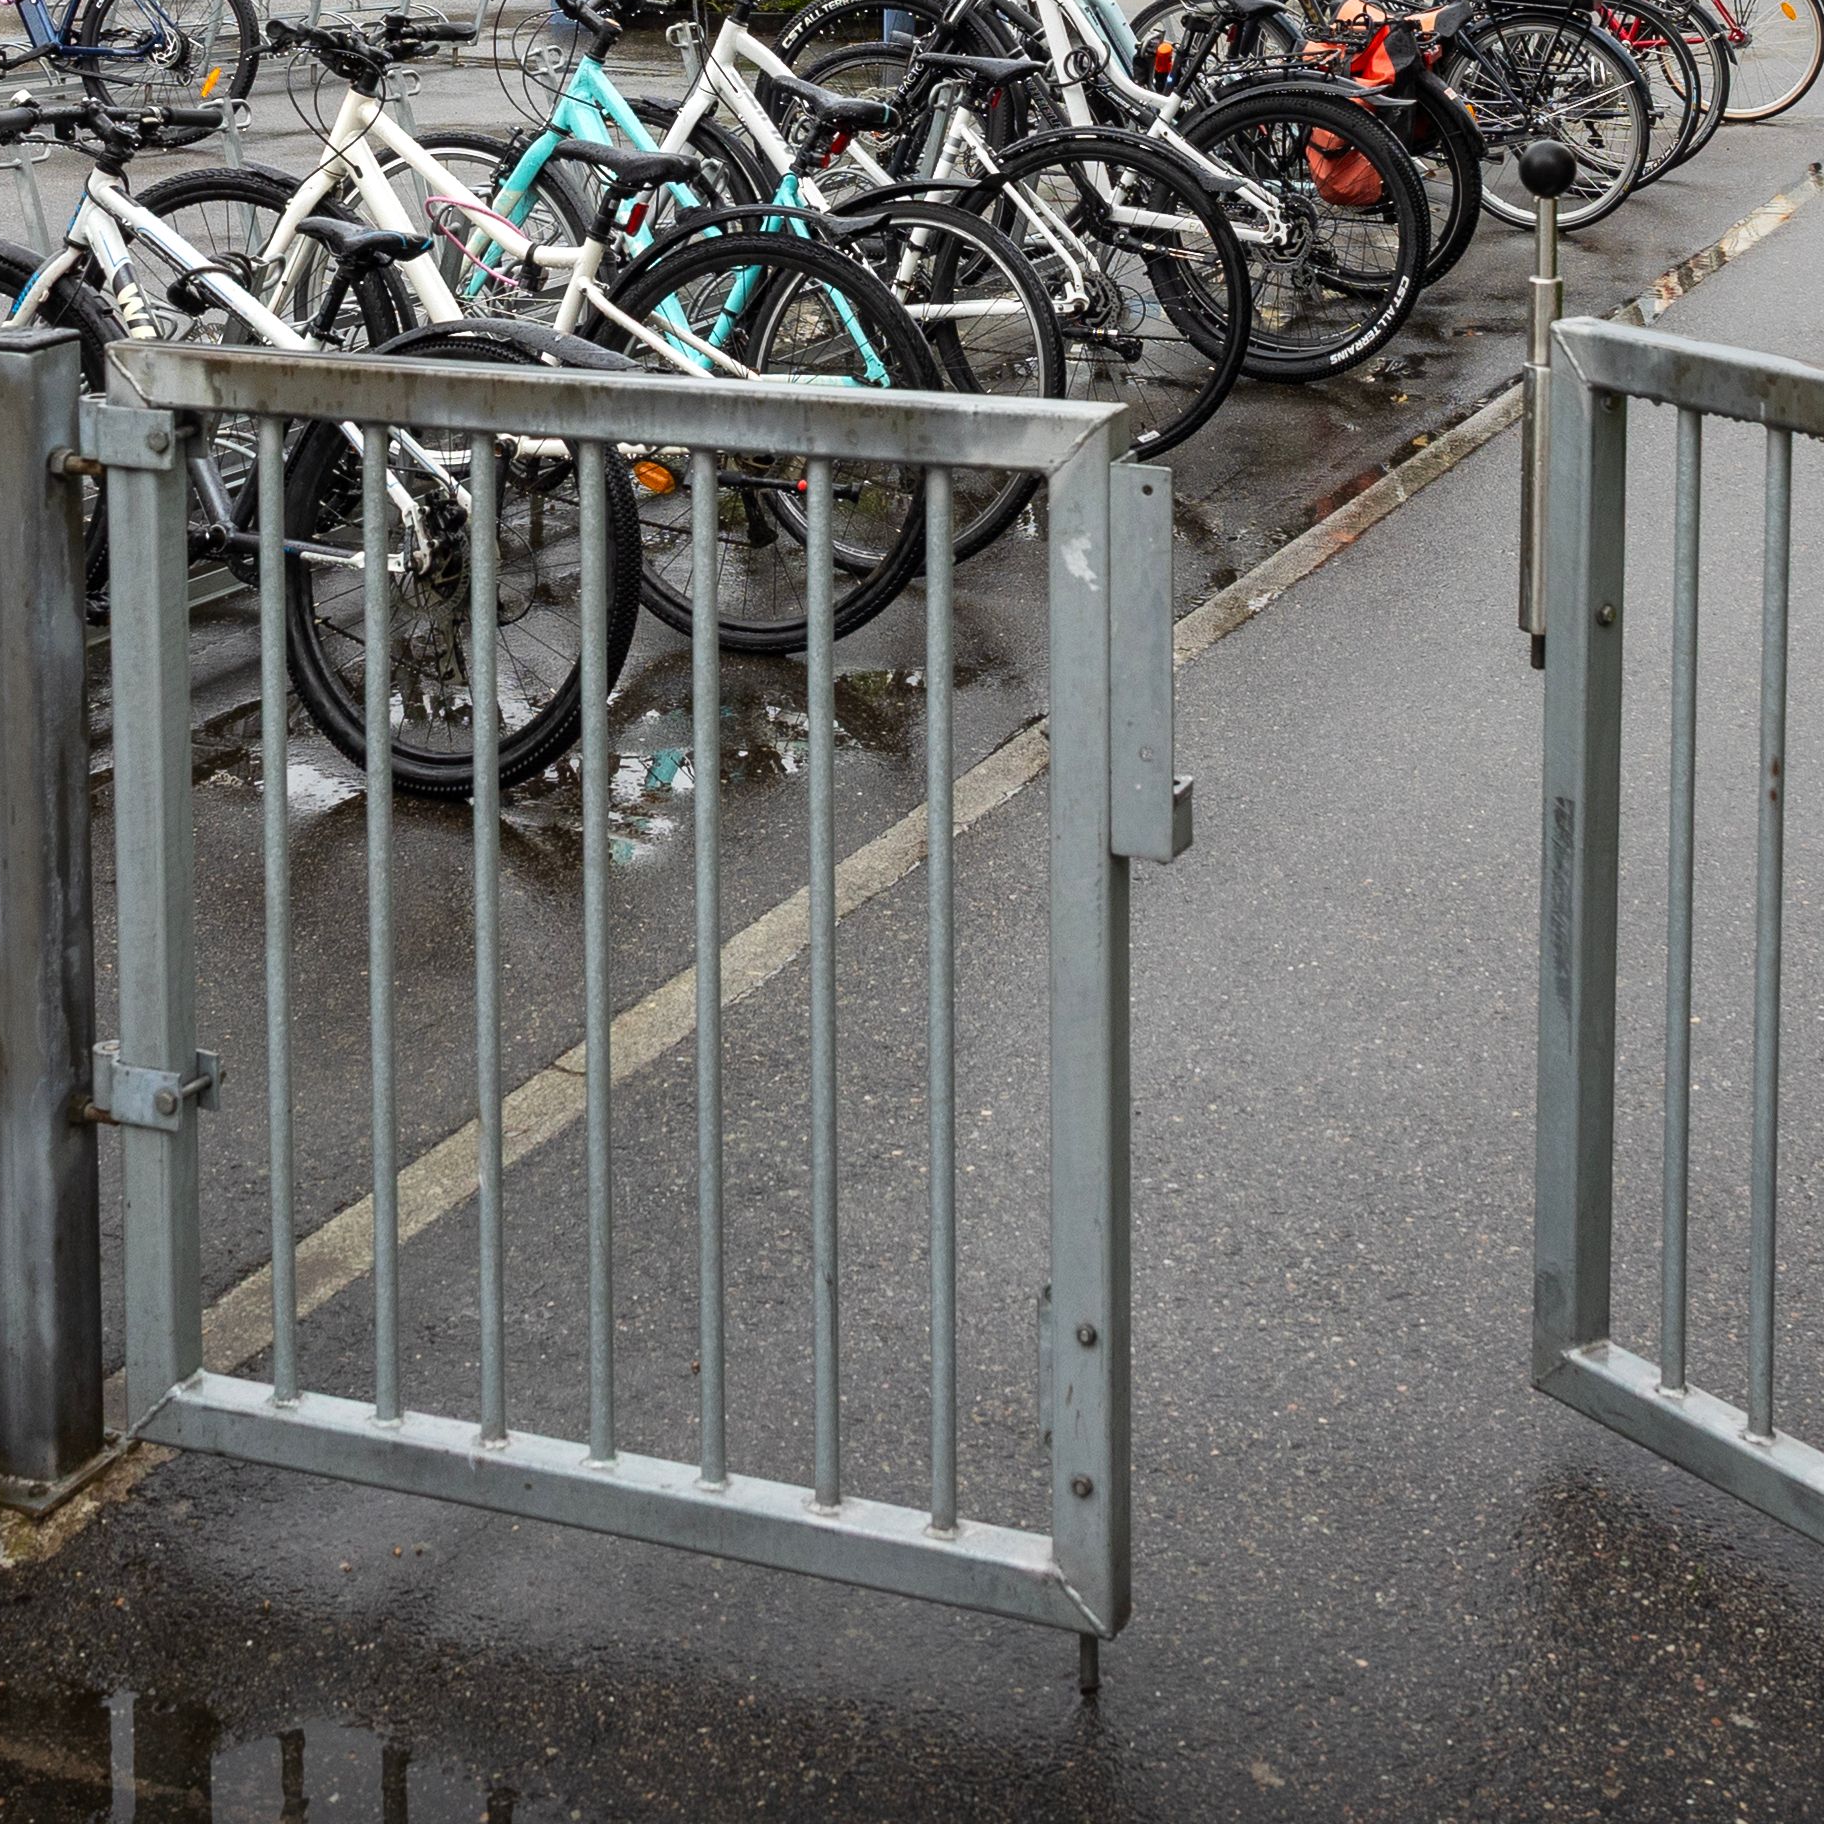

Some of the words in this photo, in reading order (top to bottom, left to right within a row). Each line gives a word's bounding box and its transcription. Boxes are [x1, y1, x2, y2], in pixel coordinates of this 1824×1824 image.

[781, 22, 804, 49] CST
[804, 9, 824, 27] ALL
[1393, 275, 1410, 308] CST
[1377, 304, 1395, 326] ALL
[1329, 325, 1382, 365] TERRAINS
